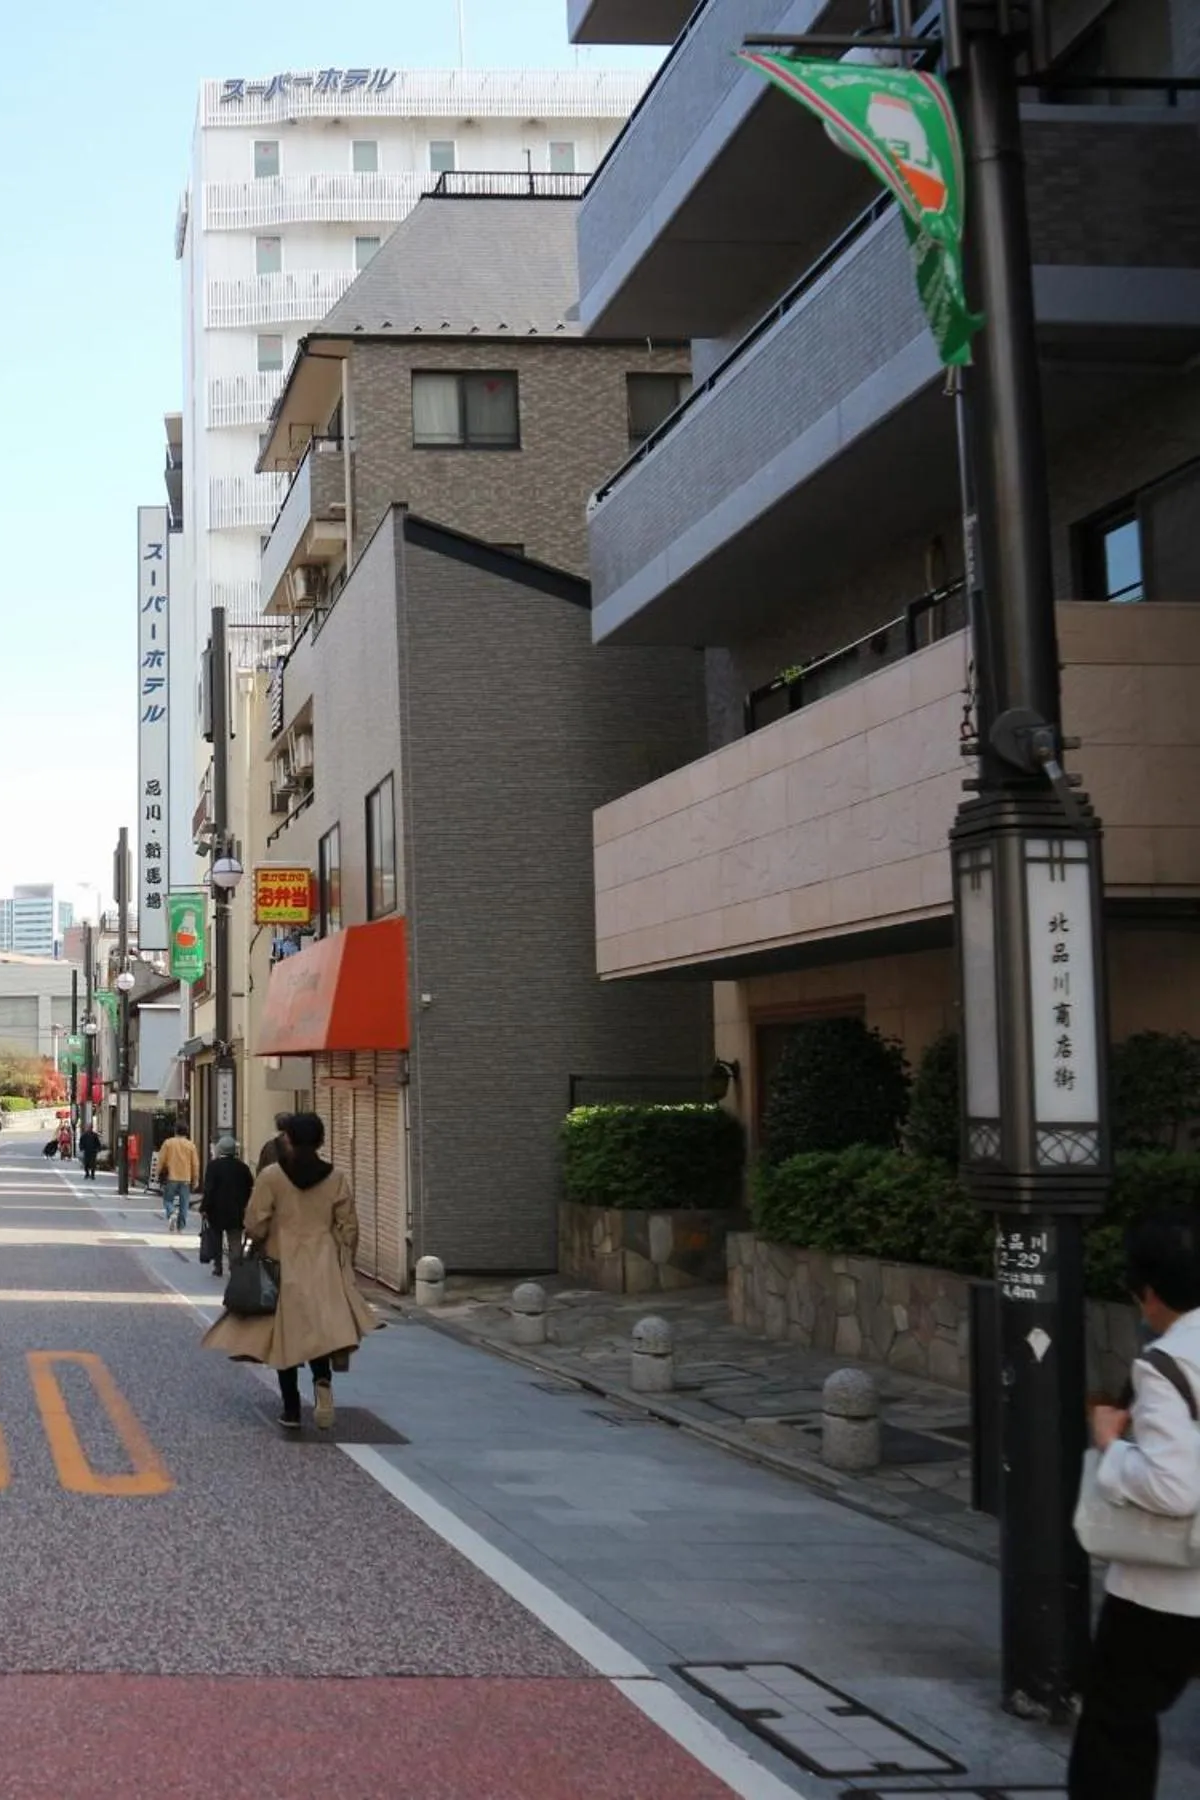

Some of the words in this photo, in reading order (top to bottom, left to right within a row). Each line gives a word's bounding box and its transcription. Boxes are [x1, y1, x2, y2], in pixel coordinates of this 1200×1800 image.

[220, 67, 396, 103] スーパーホテル
[142, 543, 166, 723] スーパーホテル
[258, 887, 307, 908] お弁当
[1048, 911, 1077, 1091] 北品川商店街
